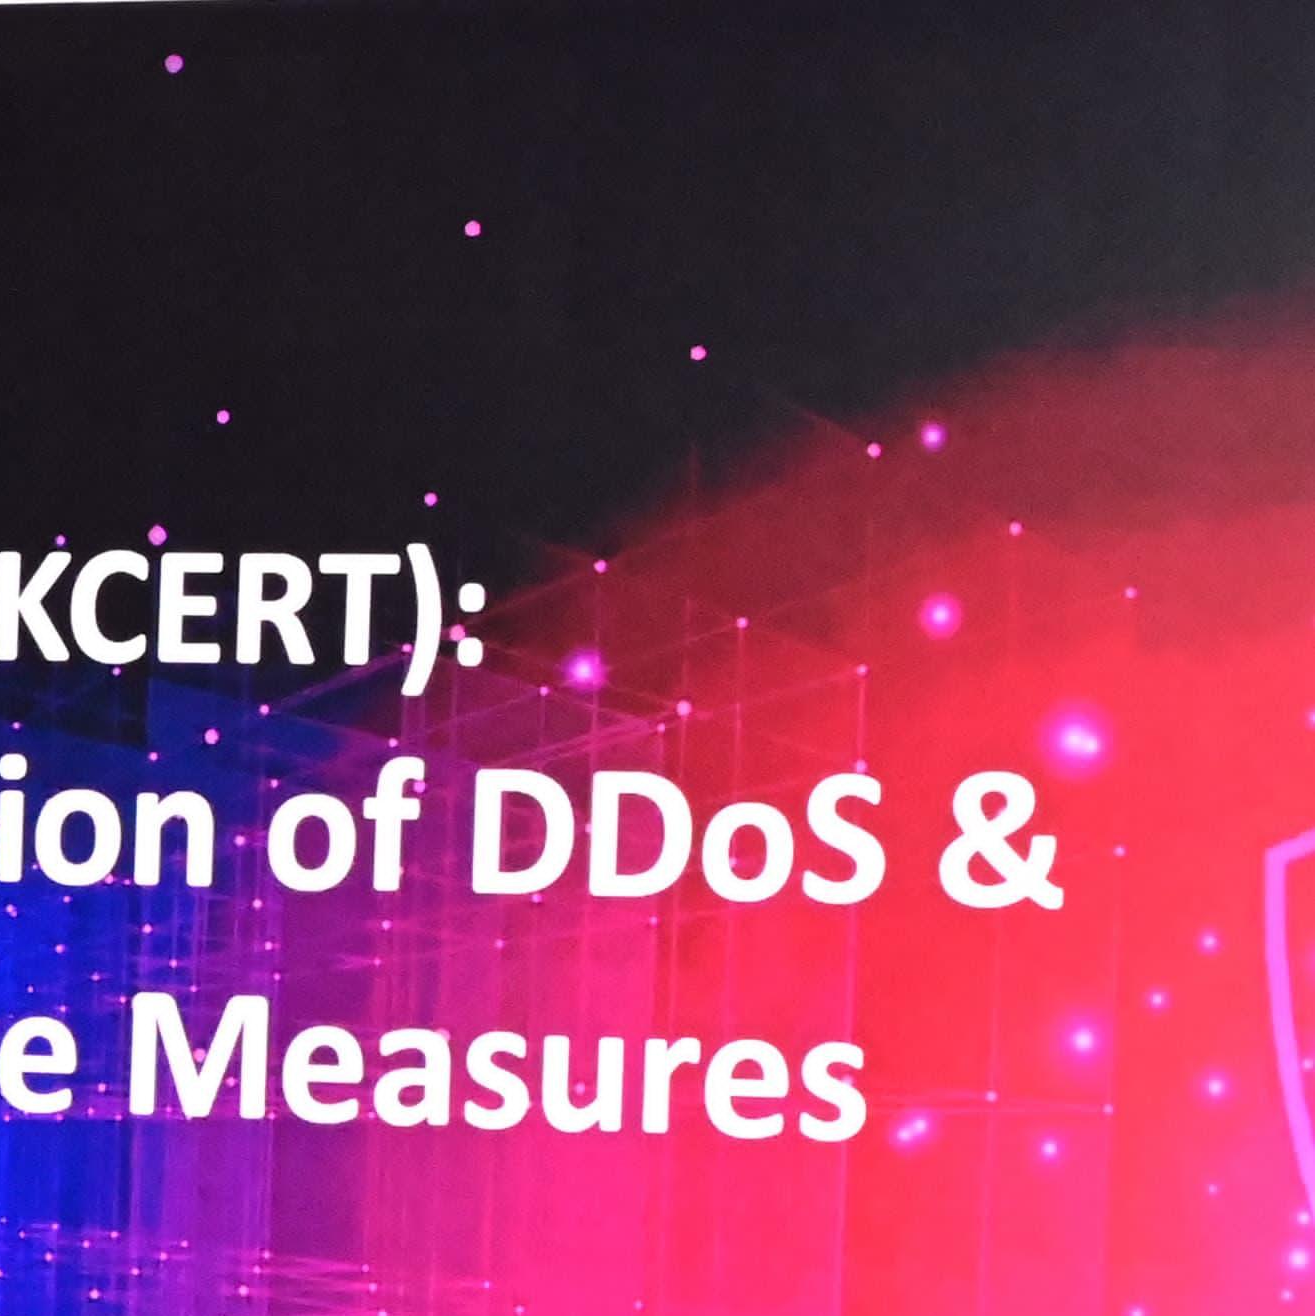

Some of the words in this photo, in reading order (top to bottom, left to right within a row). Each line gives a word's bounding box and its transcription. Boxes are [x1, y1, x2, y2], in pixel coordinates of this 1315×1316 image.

[267, 755, 426, 893] of
[471, 768, 887, 906] DDoS
[938, 770, 1065, 911] &
[129, 991, 868, 1143] Measures
